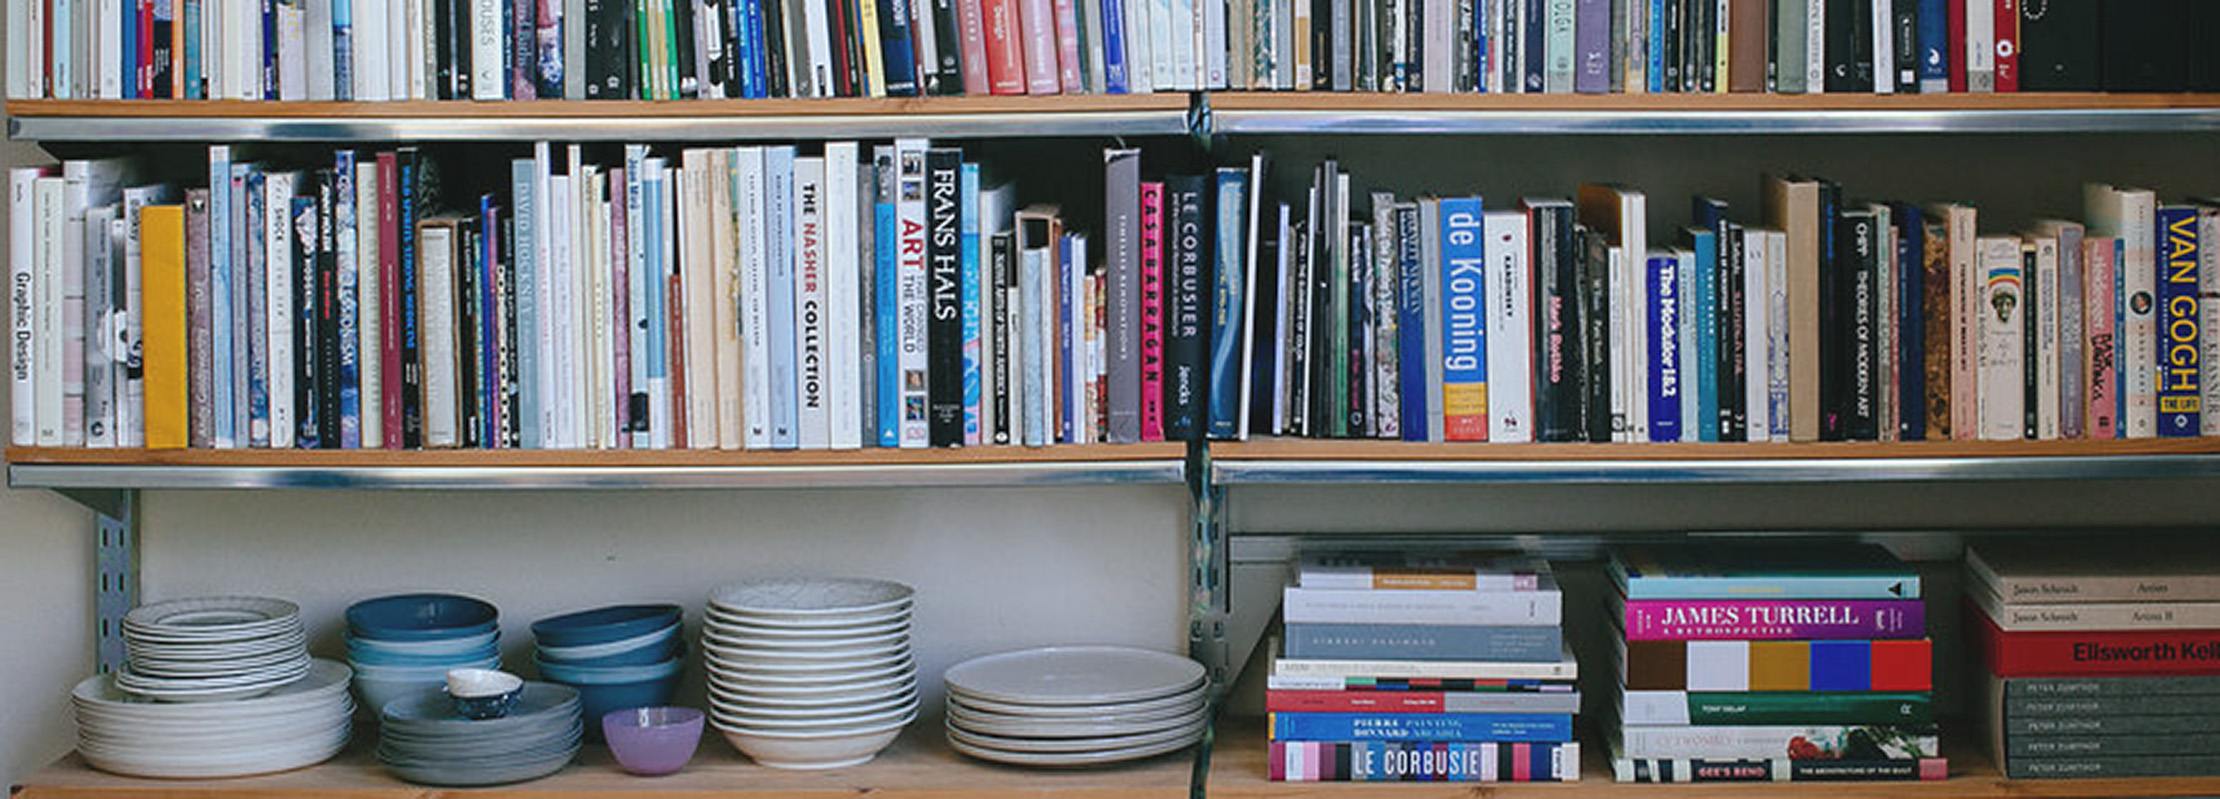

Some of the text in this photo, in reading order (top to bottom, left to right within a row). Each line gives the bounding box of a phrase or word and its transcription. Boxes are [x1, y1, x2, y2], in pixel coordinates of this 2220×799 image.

[629, 159, 639, 182] Joan
[275, 208, 285, 241] SHOCK
[517, 182, 531, 230] DAVID
[1144, 189, 1157, 249] CASA
[933, 168, 957, 321] FRANS HALS
[1182, 192, 1198, 338] LE CORBUSIER
[519, 237, 532, 314] HOCKNEY
[903, 218, 925, 353] ART THAT CHANGED
[1298, 263, 1306, 278] THE
[1504, 254, 1514, 318] KANDINSKY
[803, 183, 820, 409] THE NASHER COLLECTION
[1297, 279, 1305, 320] ELEMENTS
[1445, 212, 1483, 371] de Kooning
[2092, 257, 2108, 329] Heidegger
[2169, 215, 2198, 391] VAN GOGH
[14, 272, 31, 381] Graphic Design
[903, 275, 915, 353] THE WORLD
[1659, 265, 1677, 398] The Modulor 1&2
[1857, 222, 1870, 418] CHIPP THEORIES OF MODERN ART
[995, 324, 1006, 355] NORTH
[1549, 295, 1564, 383] Mark Rothko
[996, 356, 1007, 396] AMERICA
[2207, 307, 2219, 414] LEE KRASNER
[1177, 365, 1191, 406] Jencks
[2163, 398, 2178, 410] THE
[2013, 583, 2040, 595] Jason
[2136, 582, 2169, 593] Artists
[1661, 605, 1860, 626] JAMES TURRELL
[1677, 627, 1793, 635] RETROSPECTIVE
[2013, 612, 2040, 624] Jason
[2073, 641, 2178, 662] Ellsworth
[1354, 719, 1398, 727] PIERRE
[1702, 705, 1721, 713] TONY
[1354, 728, 1409, 737] BONNARD
[1354, 749, 1375, 775] LE
[1698, 766, 1766, 777] GEE'S BEND
[1815, 766, 1865, 775] ARCHITECTURE
